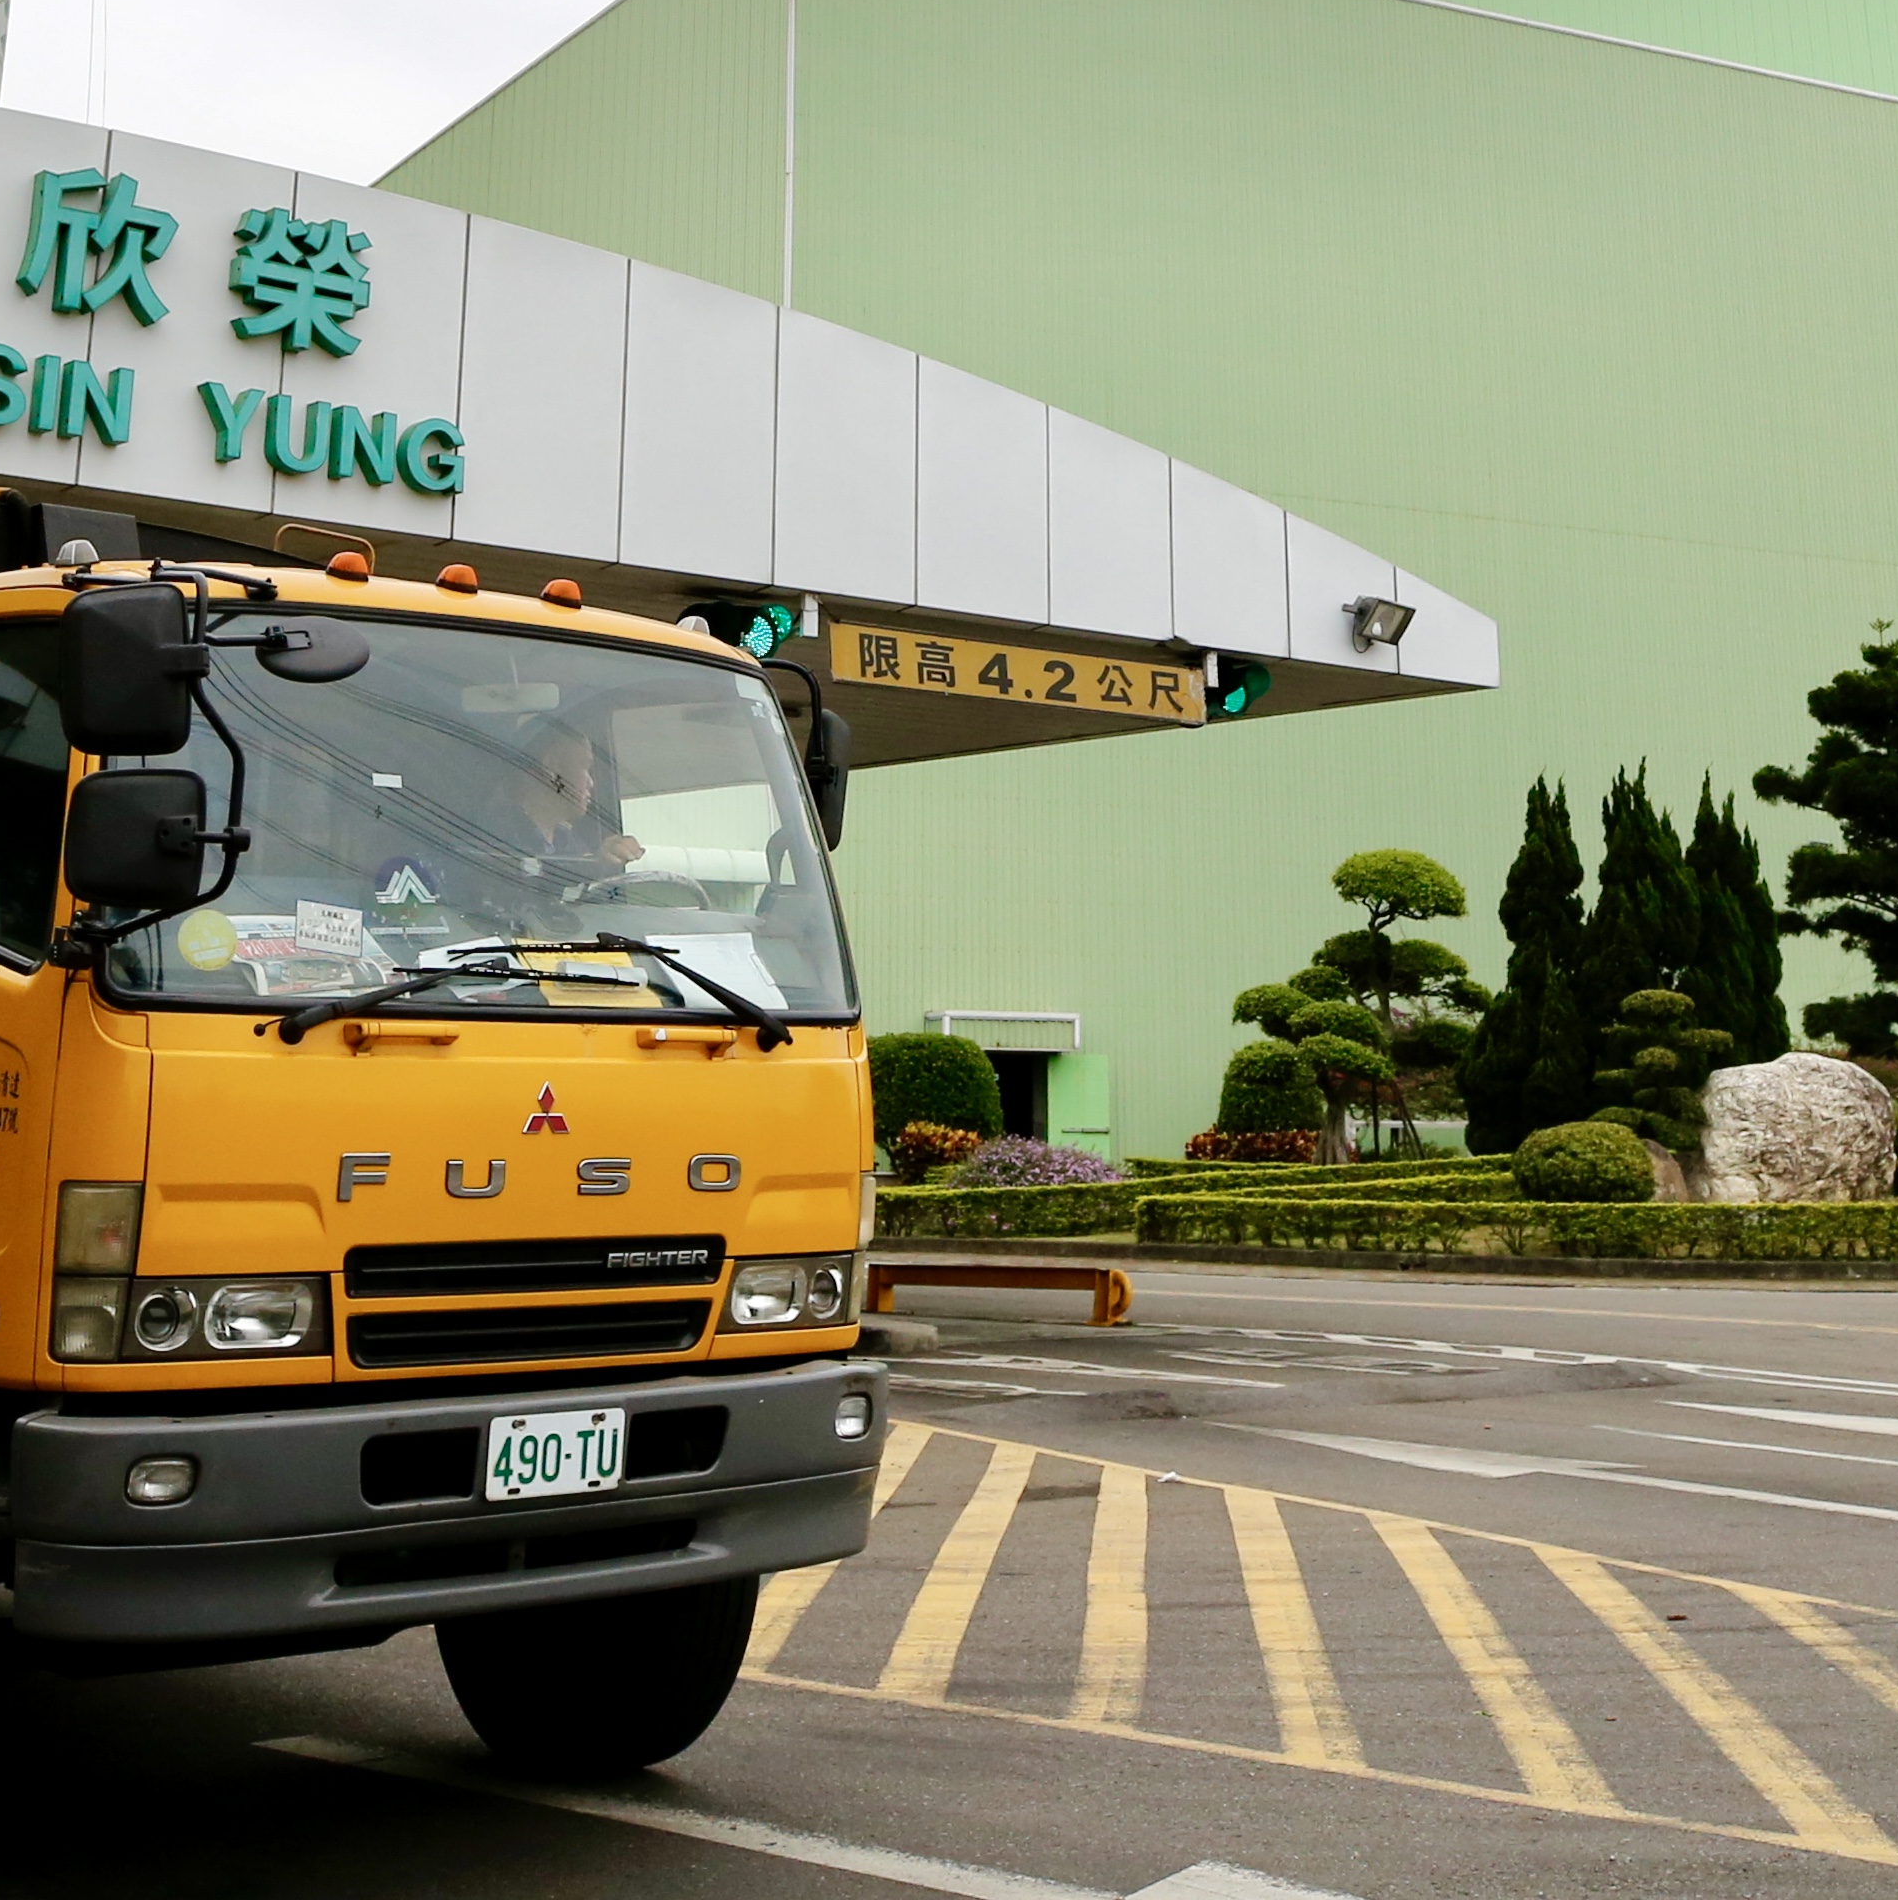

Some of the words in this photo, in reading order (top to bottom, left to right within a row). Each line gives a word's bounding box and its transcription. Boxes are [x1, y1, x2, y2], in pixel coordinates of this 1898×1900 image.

[15, 167, 372, 358] 欣榮
[197, 381, 464, 495] YUNG
[858, 632, 1185, 713] 限高4.2公尺
[337, 1151, 742, 1203] FUSO
[607, 1248, 709, 1270] FIGHTER
[493, 1427, 620, 1489] 490-TU
